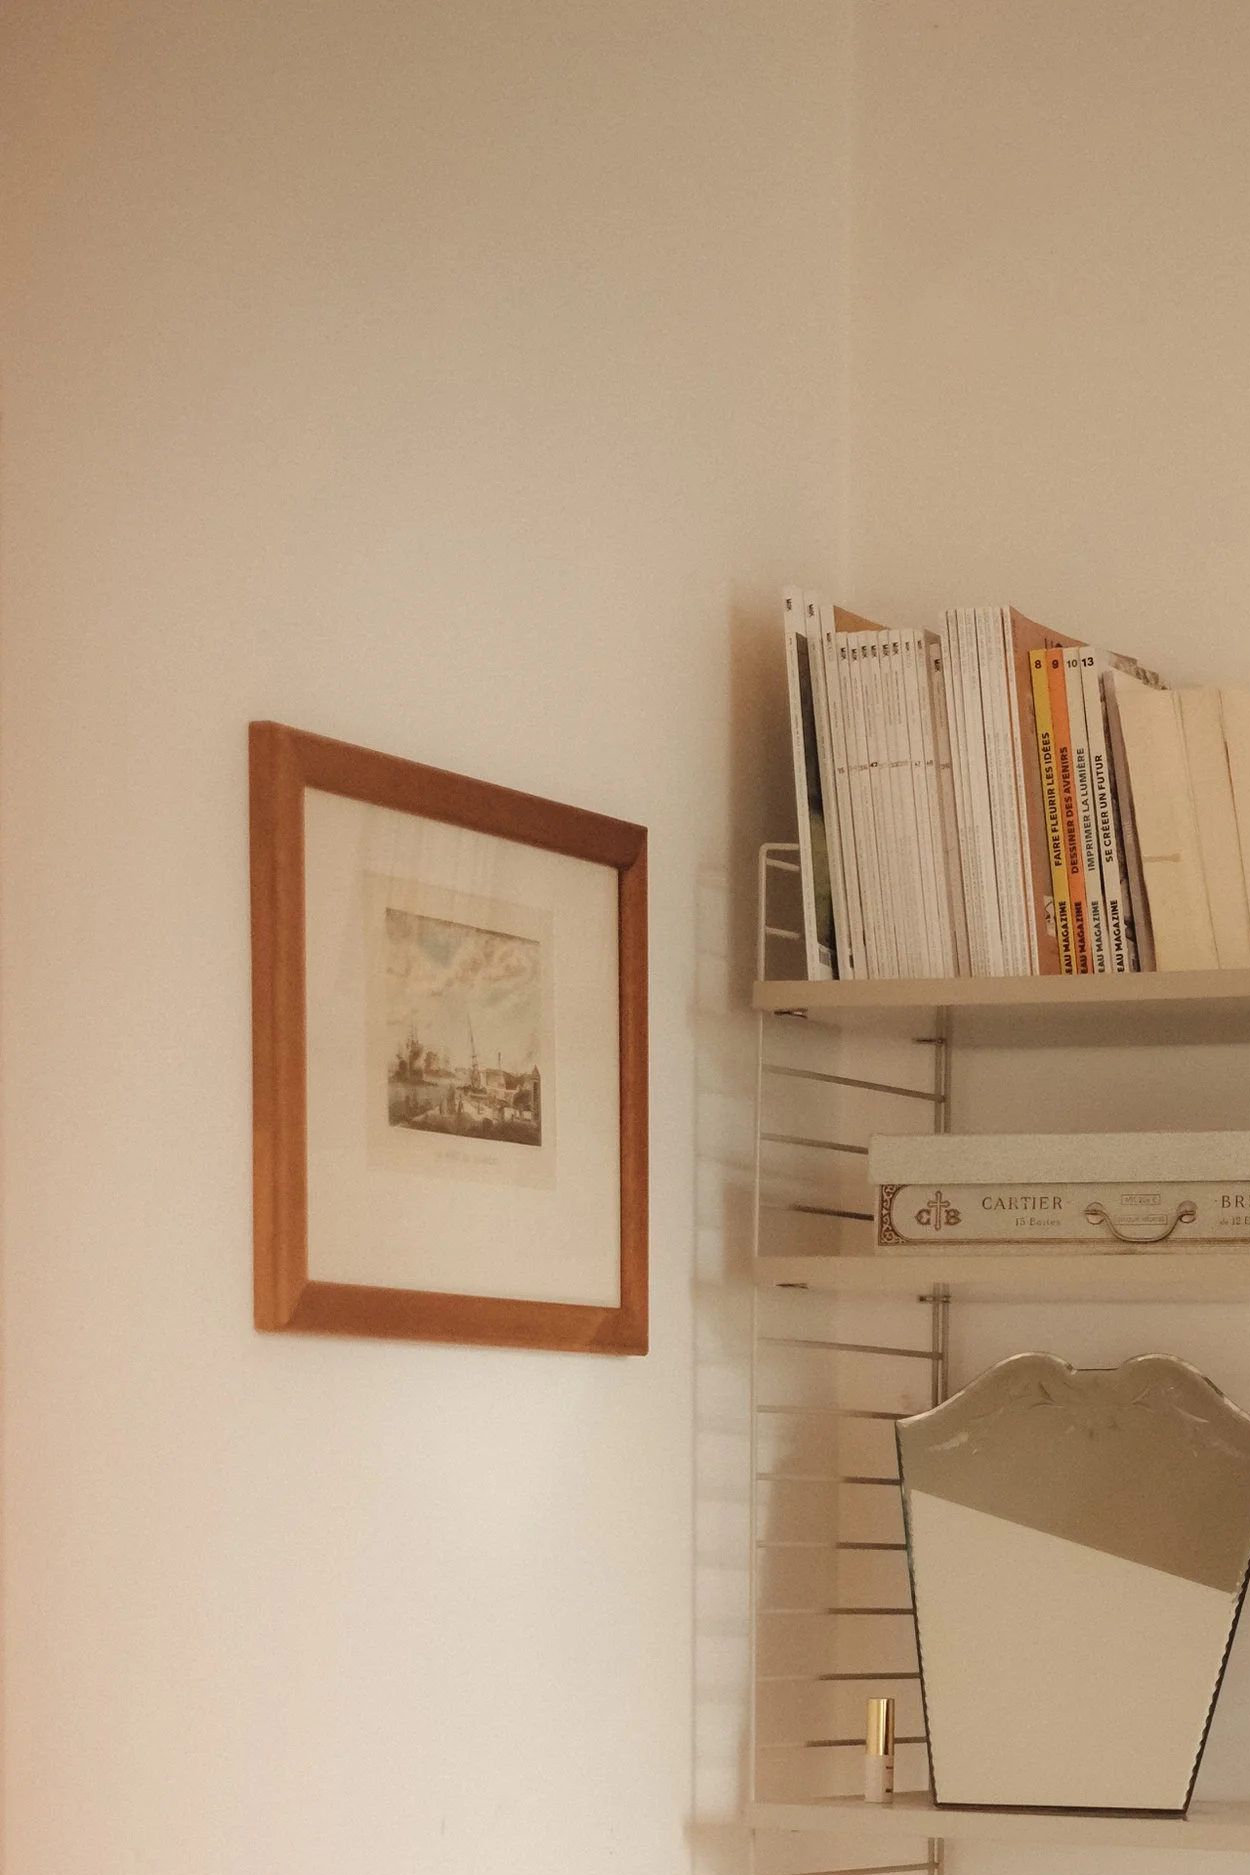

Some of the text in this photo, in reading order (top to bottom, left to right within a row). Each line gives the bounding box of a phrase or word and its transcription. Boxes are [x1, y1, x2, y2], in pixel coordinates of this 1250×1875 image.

[1034, 659, 1042, 669] 8
[1051, 659, 1059, 669] 9
[1067, 659, 1078, 668] 10
[1081, 657, 1094, 667] 13
[1042, 731, 1062, 867] FAIRE FLEURIR LES IDÉES
[1060, 746, 1079, 874] DESSINER DES AVENIRS
[1076, 748, 1096, 872] IMPRIMER LA LUMIÈRE
[1094, 754, 1114, 863] SE CRÉER UN FUTUR
[1059, 901, 1073, 975] EAU MAGAZINE
[1074, 902, 1086, 953] MAGAZINE
[1091, 900, 1104, 952] MAGAZINE
[1110, 900, 1123, 951] MAGAZINE
[982, 1195, 1063, 1211] CARTIER
